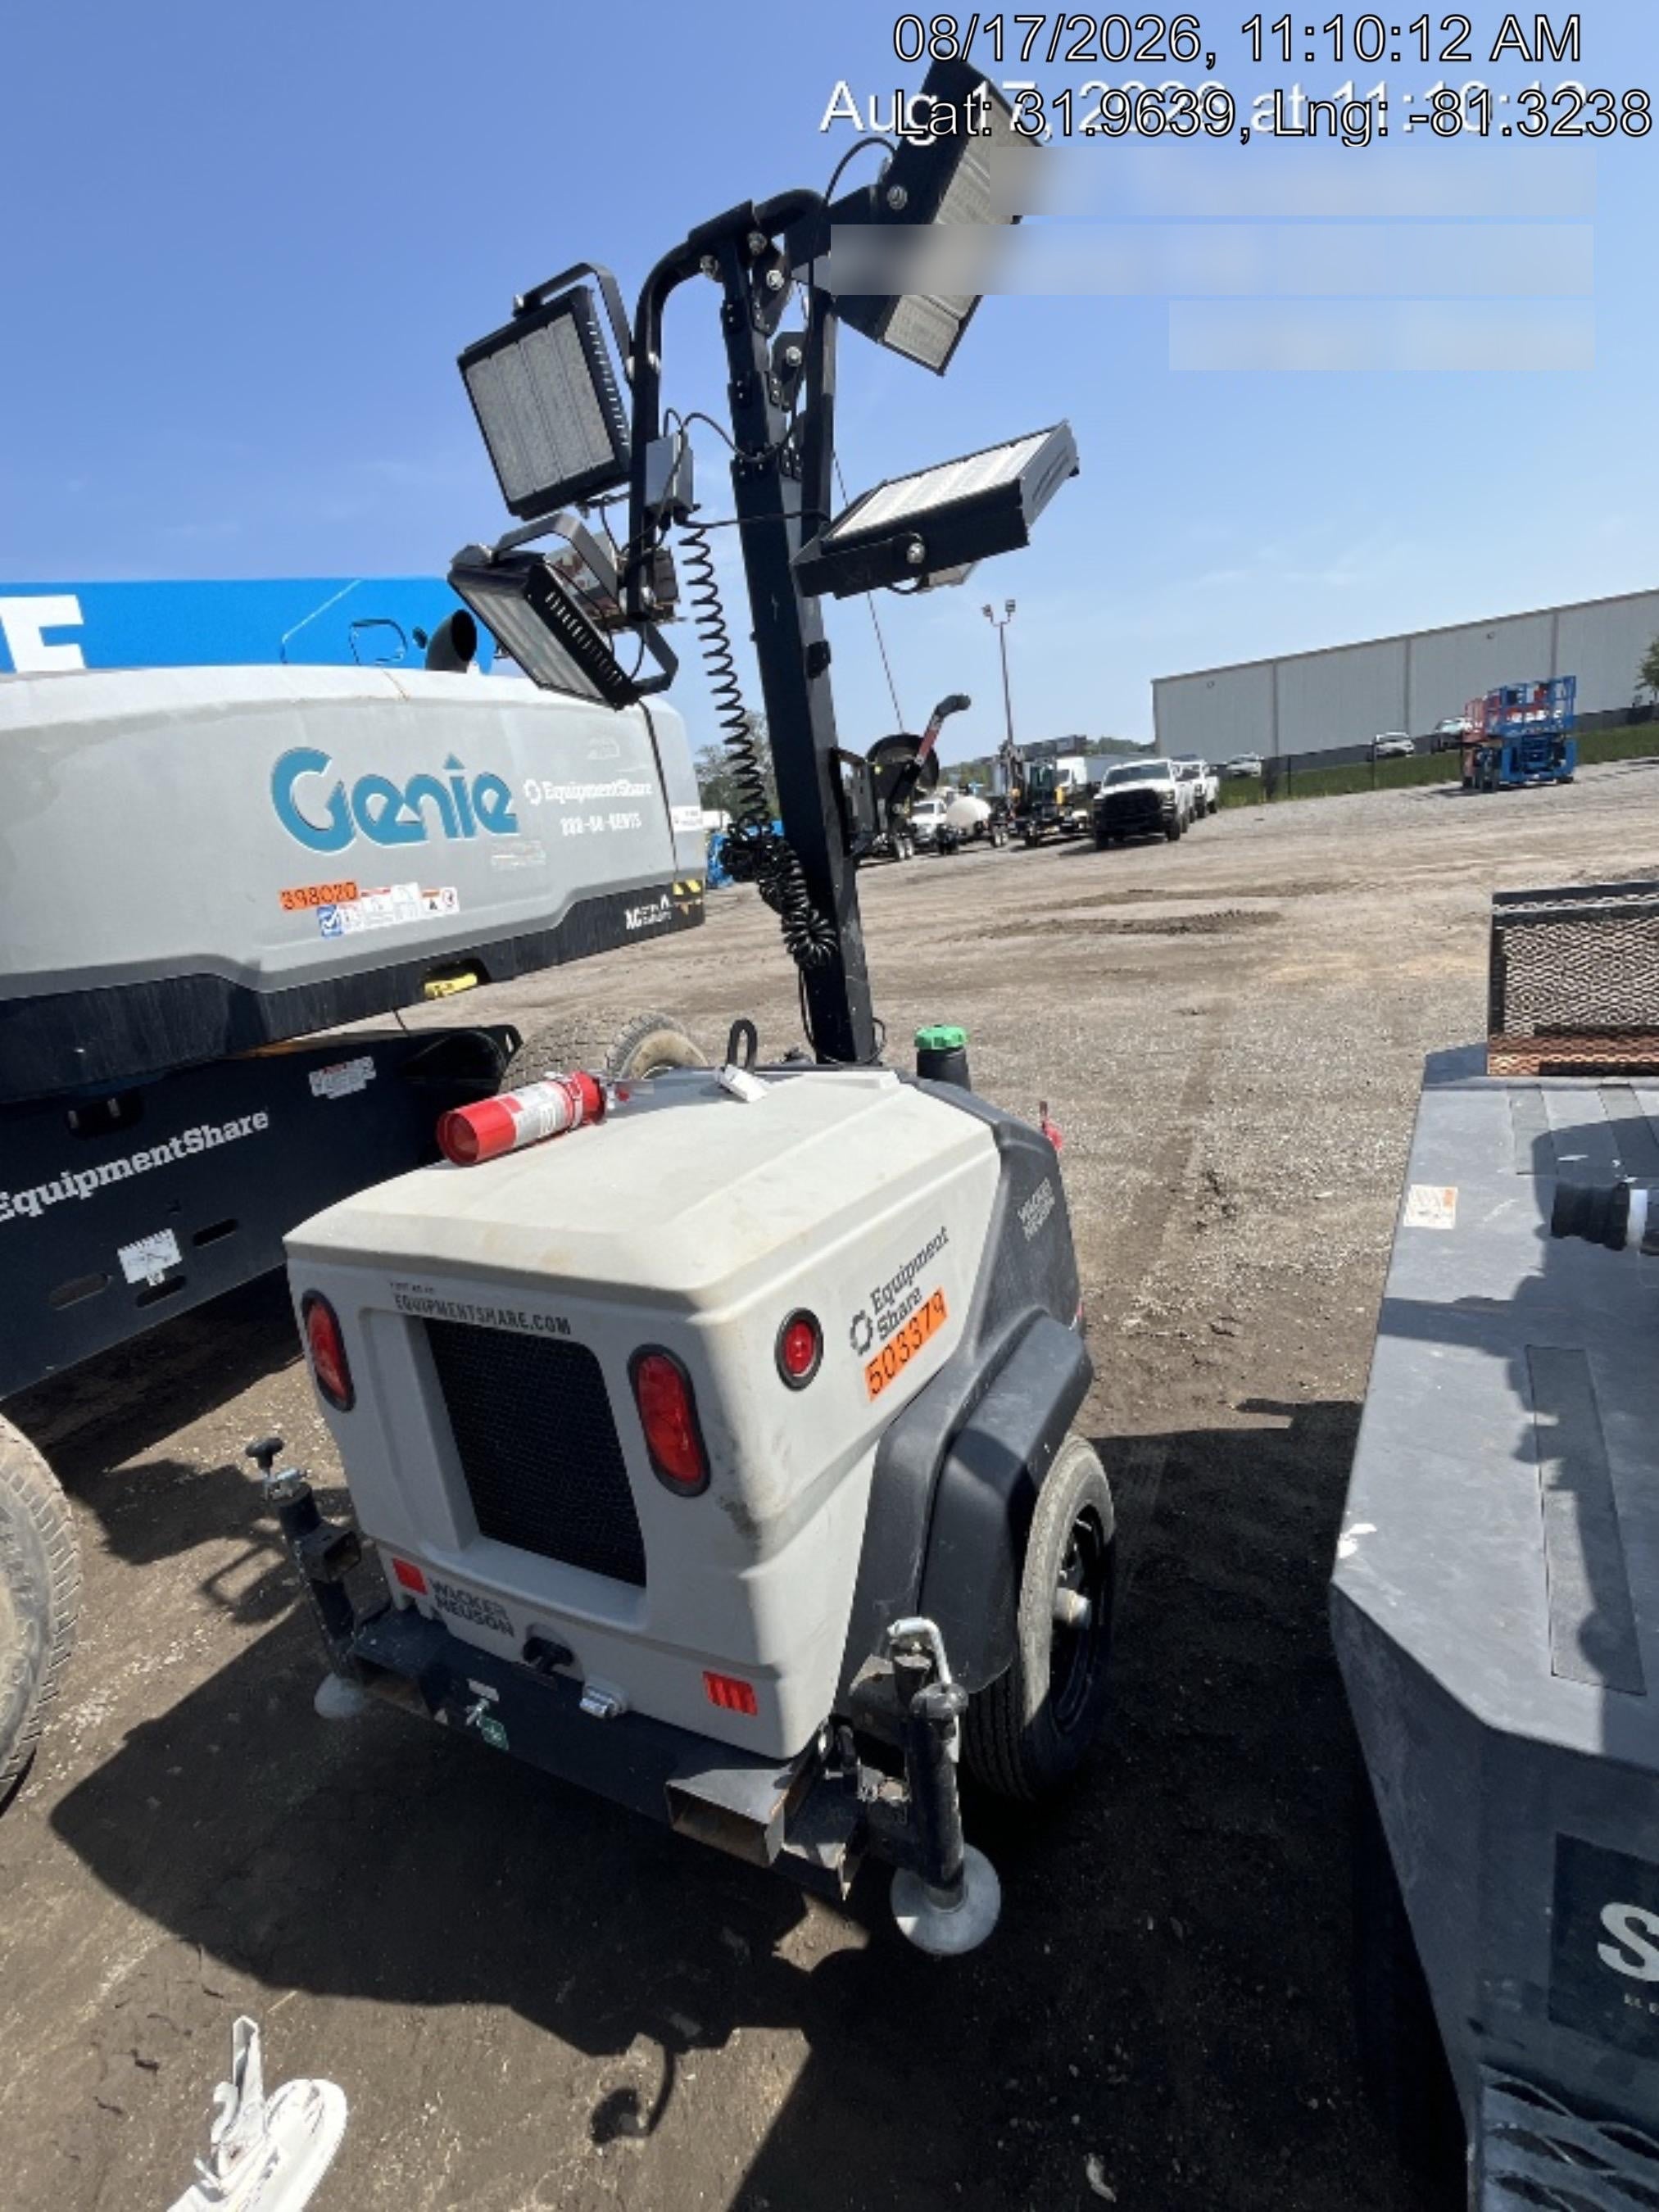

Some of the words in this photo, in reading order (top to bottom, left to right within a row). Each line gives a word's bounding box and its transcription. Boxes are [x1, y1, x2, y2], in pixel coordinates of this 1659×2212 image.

[270, 746, 520, 856] Genie
[0, 1111, 270, 1222] EquipmentShare
[394, 1294, 572, 1335] EQUIPMENTSHARE.COM
[870, 1226, 950, 1315] Equipment
[877, 1286, 922, 1340] Share
[868, 1290, 946, 1395] 503379
